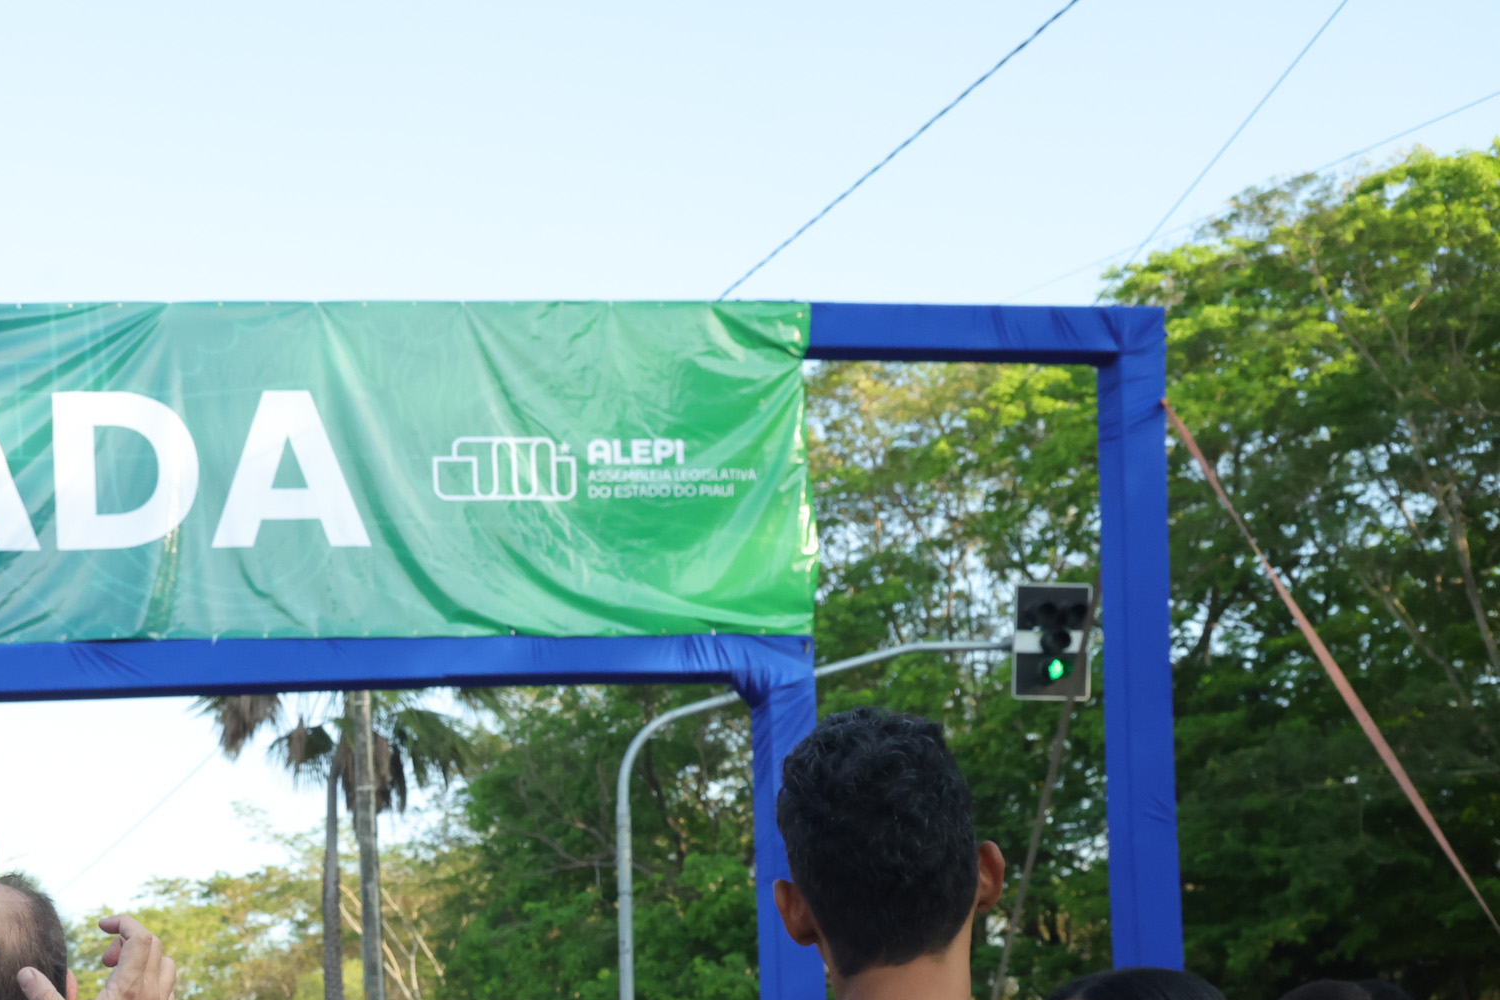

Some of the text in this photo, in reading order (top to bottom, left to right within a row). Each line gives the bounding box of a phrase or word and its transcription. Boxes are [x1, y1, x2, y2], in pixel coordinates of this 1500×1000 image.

[587, 438, 685, 466] ALEPI
[587, 467, 757, 483] ASSEMBLEIA LEGISLATIVA
[587, 484, 612, 499] DO
[614, 483, 671, 499] ESTADO
[673, 483, 697, 498] DO
